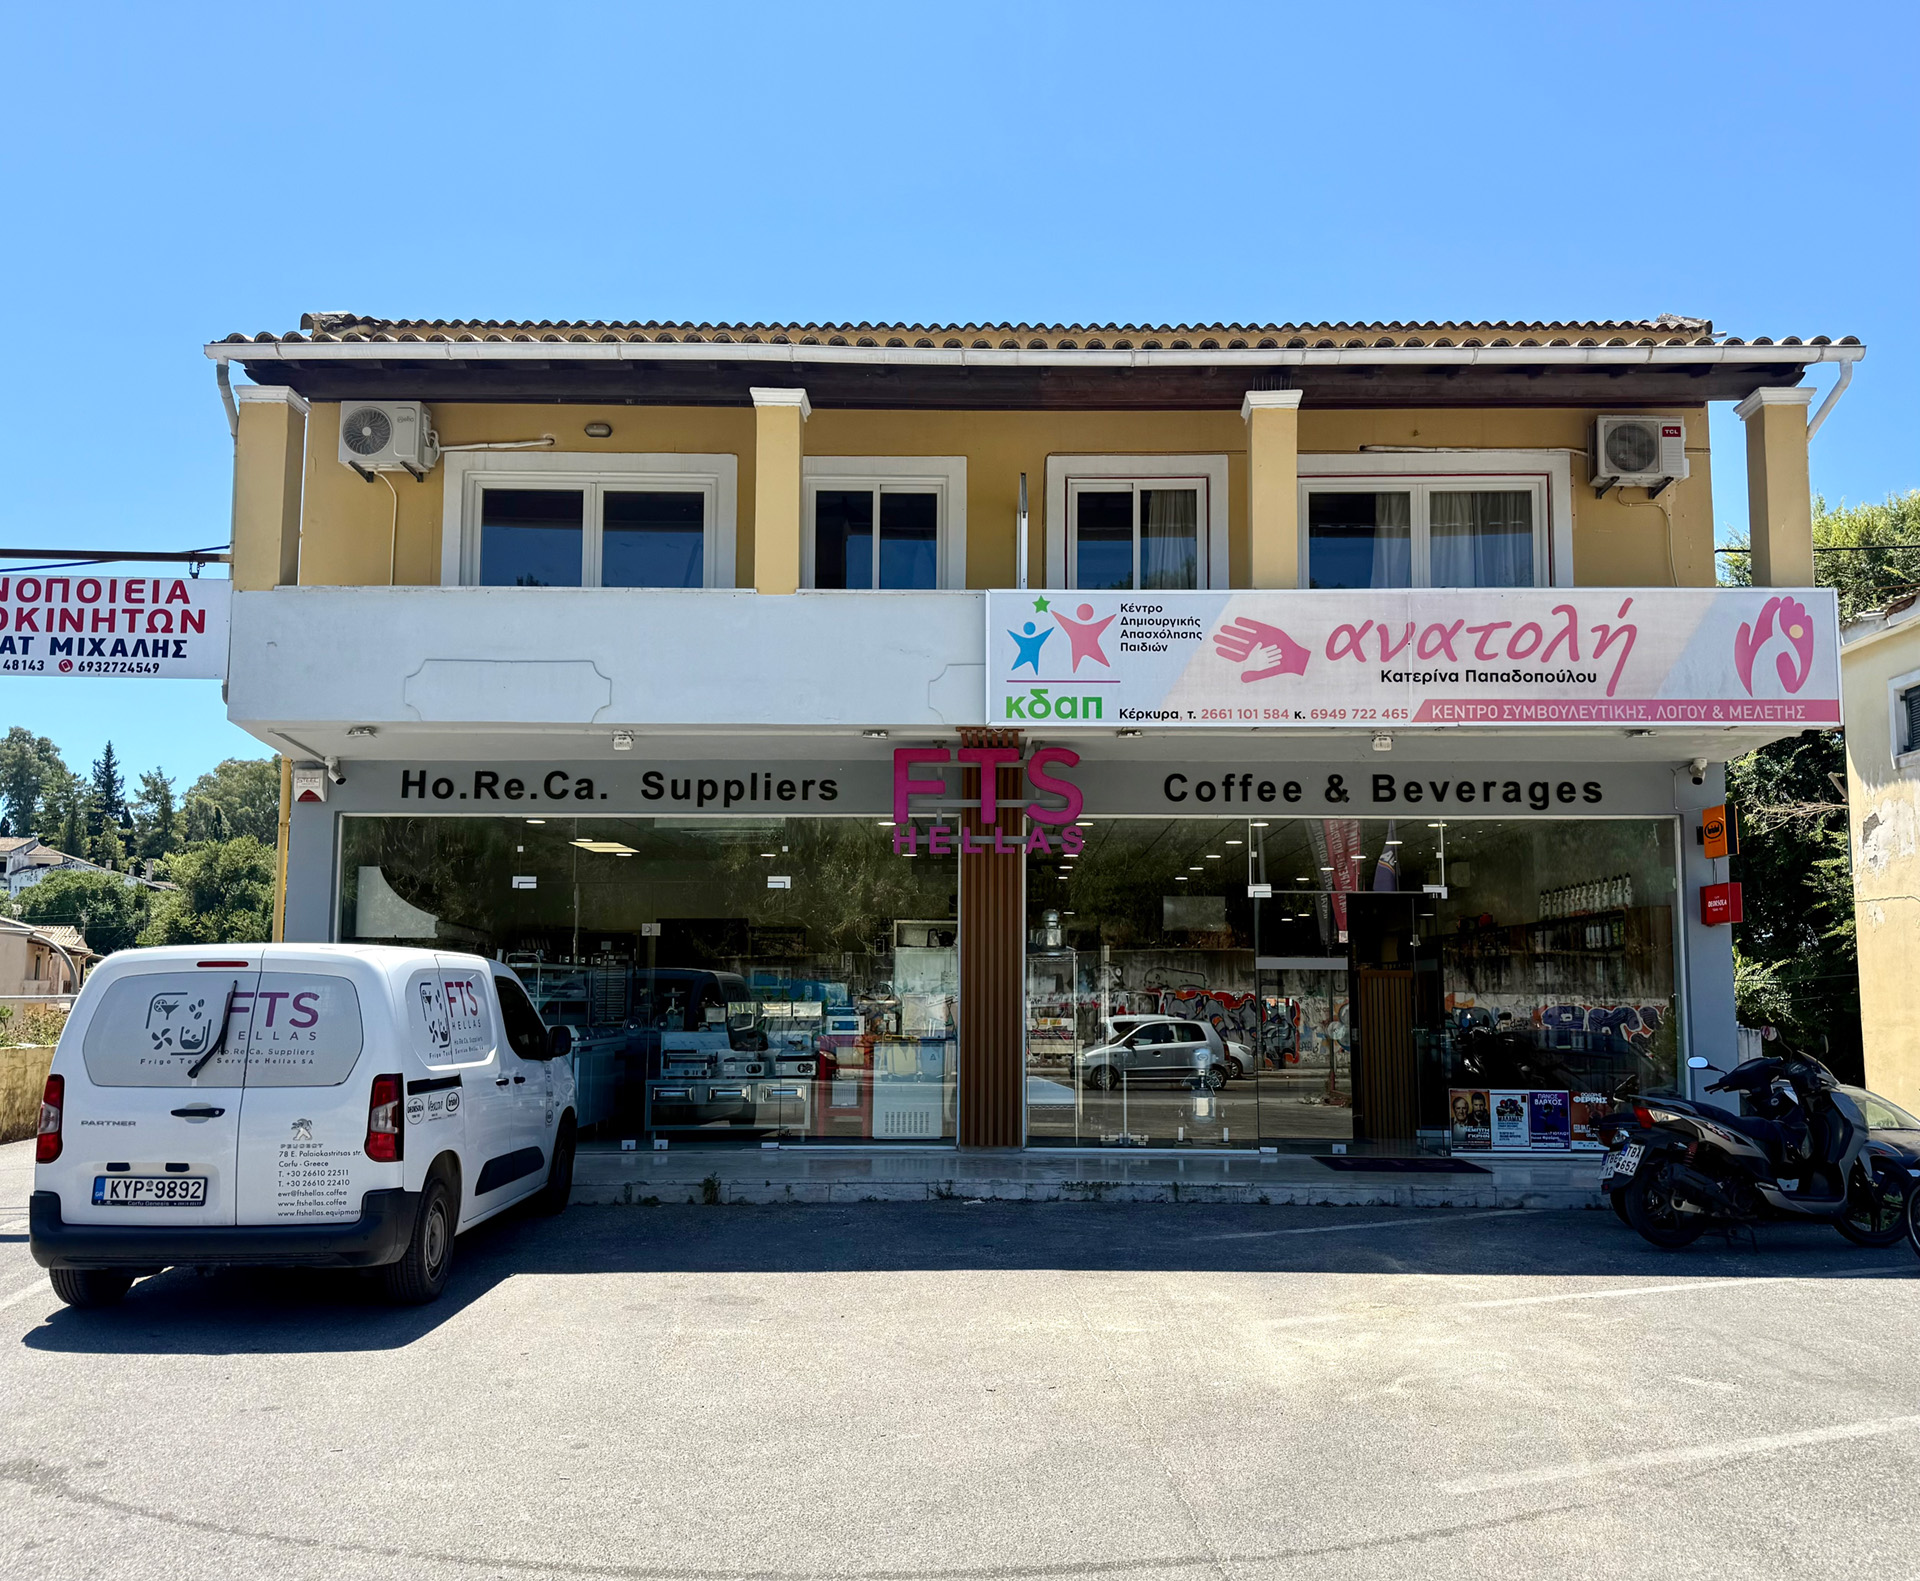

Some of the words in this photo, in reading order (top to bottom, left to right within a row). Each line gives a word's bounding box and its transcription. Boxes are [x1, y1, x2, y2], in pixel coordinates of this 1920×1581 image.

[1120, 603, 1163, 614] Κέντρο
[1120, 616, 1201, 628] Δημιουργικής
[1120, 629, 1202, 640] Απασχόλησης
[49, 637, 188, 658] ΜΙΧΑΛΗΣ
[1120, 642, 1168, 652] Παιδιών
[1326, 597, 1638, 698] ανατολή
[3, 660, 45, 672] 48143
[78, 660, 160, 674] 6932724549
[1381, 669, 1460, 686] Κατερίνα
[1466, 668, 1597, 684] Παπαδοπούλου
[1006, 688, 1102, 720] κδαπ
[1119, 708, 1184, 722] Κέρκυρα,
[1201, 708, 1233, 720] 2661
[1237, 708, 1258, 720] 101
[1263, 708, 1290, 720] 584
[1310, 708, 1347, 720] 6949
[1352, 708, 1378, 720] 722
[1382, 708, 1408, 720] 465
[1432, 706, 1498, 719] ΚΕΝΤΡΟ
[1502, 706, 1652, 721] ΣΥΜΒΟΥΛΕΥΤΙΚΗΣ,
[1656, 706, 1709, 719] ΛΟΓΟΥ
[1712, 706, 1724, 719] &
[1729, 706, 1806, 719] ΜΕΛΕΤΗΣ
[400, 770, 608, 800] Ho.Re.Ca.
[640, 771, 839, 808] Suppliers
[894, 747, 1084, 825] FTS
[1164, 773, 1302, 802] Coffee
[1324, 774, 1350, 802] &
[1372, 774, 1604, 810] Beverages
[894, 826, 1084, 854] HELLAS
[444, 981, 478, 1018] FTS
[452, 1019, 482, 1031] HELLAS
[238, 1031, 316, 1040] ELLAS
[268, 1048, 316, 1056] Suppliers
[1620, 1160, 1636, 1173] 652
[278, 1199, 347, 1207] www.ftshellas.coffee
